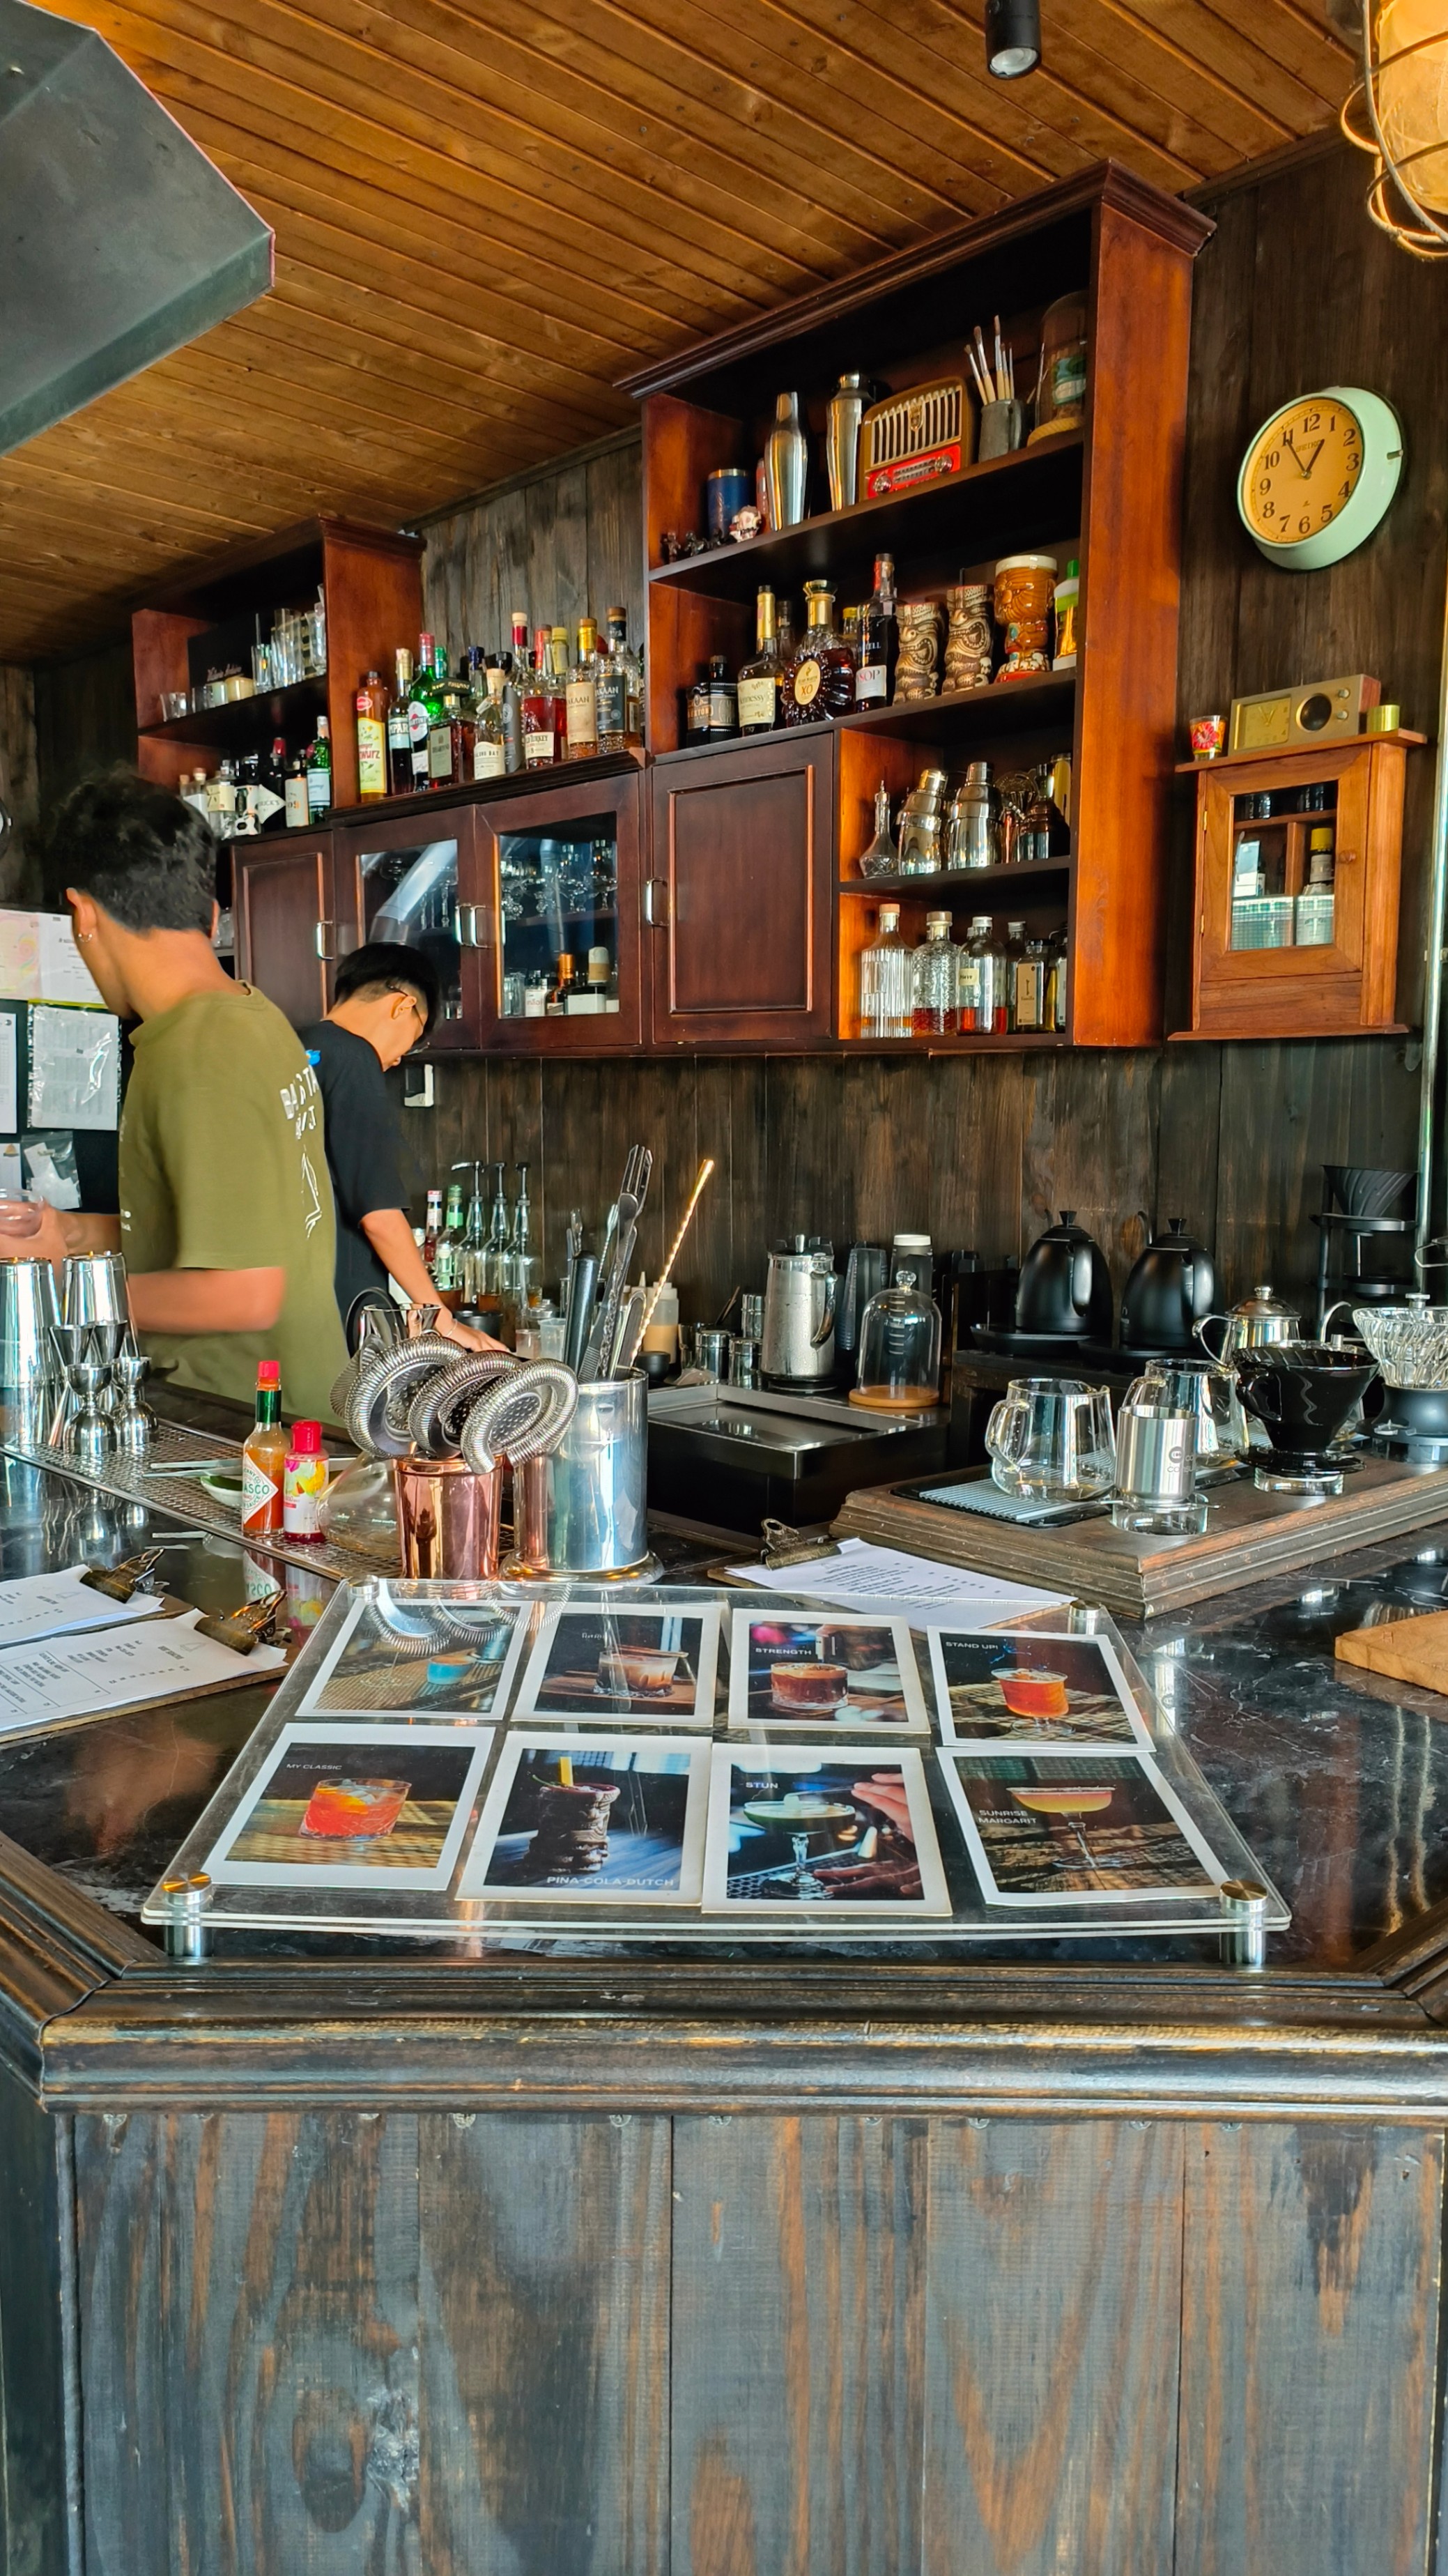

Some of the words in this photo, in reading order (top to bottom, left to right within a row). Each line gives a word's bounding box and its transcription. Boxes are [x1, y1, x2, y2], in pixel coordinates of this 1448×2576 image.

[1303, 413, 1320, 434] 12
[1330, 415, 1336, 432] 1
[1281, 429, 1294, 447] 11
[1343, 429, 1356, 447] 2
[1264, 451, 1280, 470] 10
[1346, 453, 1359, 471] 3
[1259, 478, 1271, 496] 9
[1338, 480, 1350, 498] 4
[1263, 501, 1275, 519] 8
[1320, 504, 1333, 523] 5
[1279, 514, 1291, 532] 7
[1299, 516, 1311, 535] 6
[801, 684, 813, 696] XO
[546, 1876, 674, 1886] PINA-COLA-DUTCH
